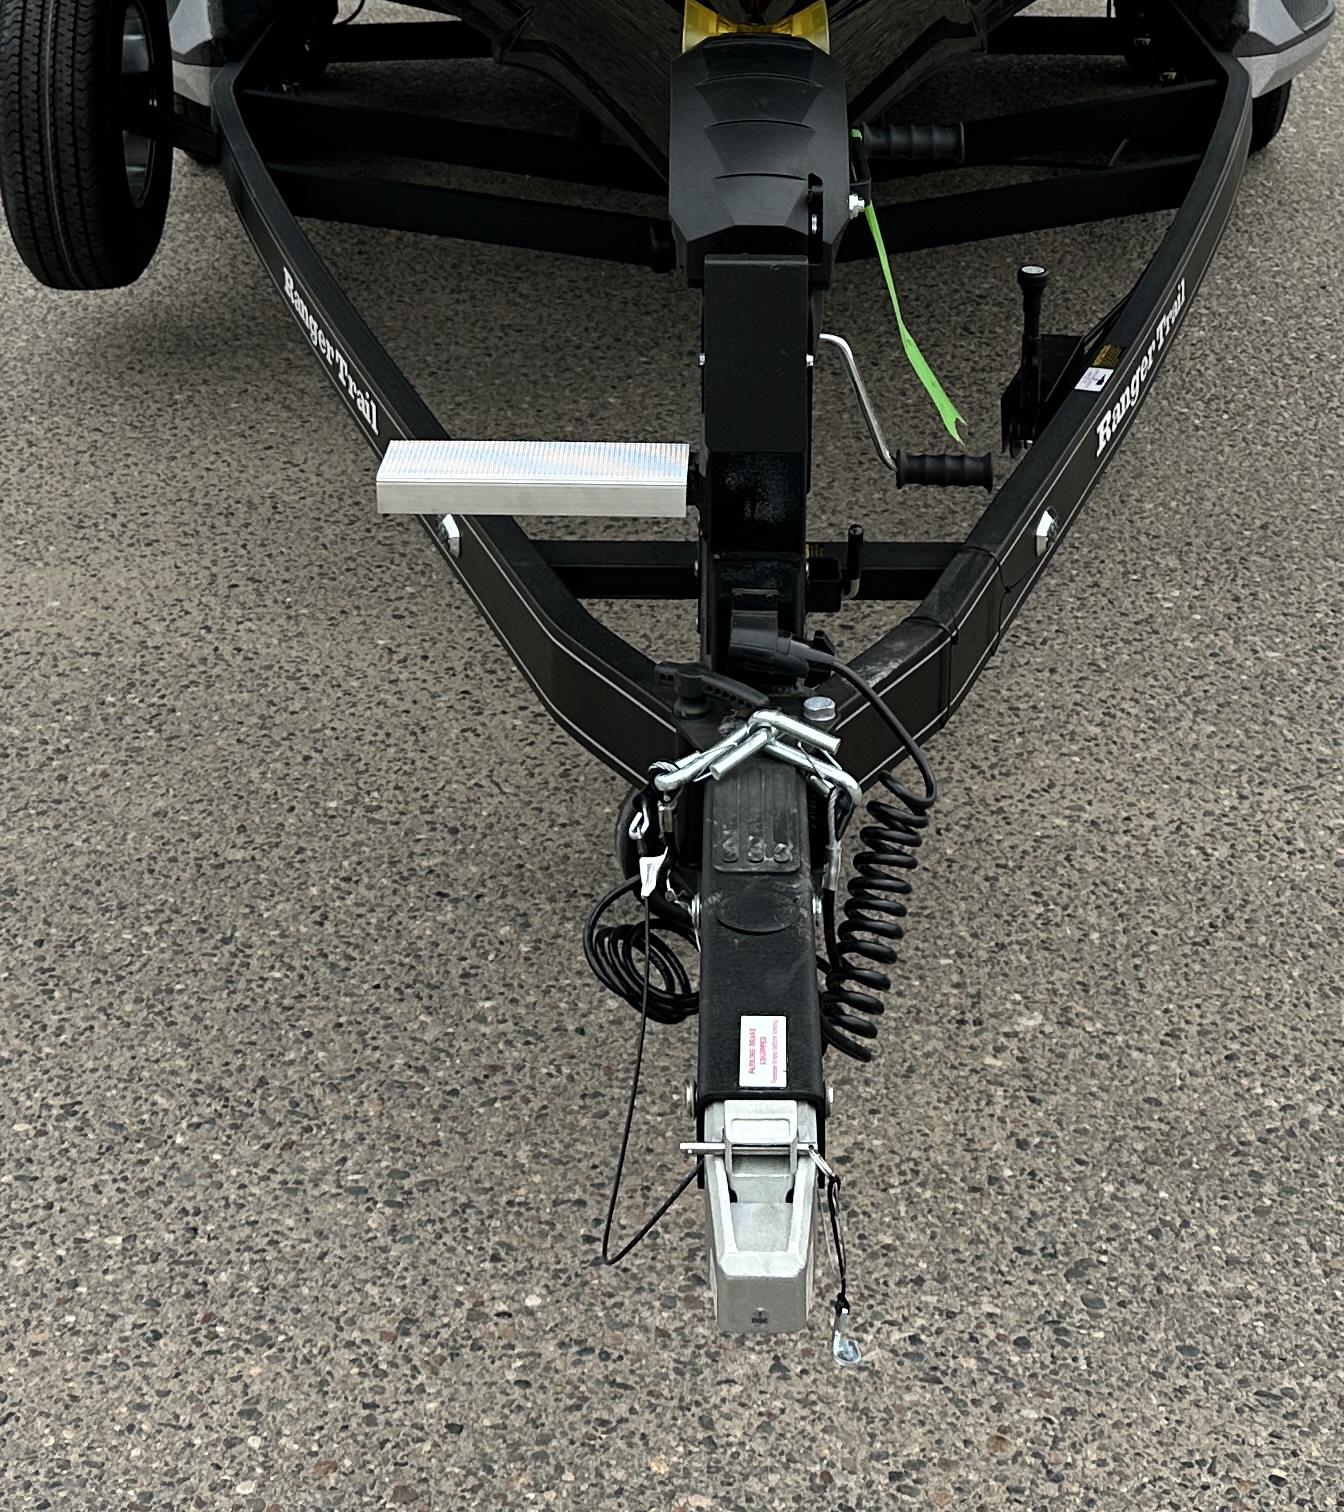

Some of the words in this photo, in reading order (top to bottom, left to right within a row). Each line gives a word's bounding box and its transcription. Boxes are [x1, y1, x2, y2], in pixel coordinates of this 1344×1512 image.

[283, 266, 335, 365] Ranger
[335, 348, 379, 435] Trail
[1096, 339, 1156, 458] Ranger
[1156, 277, 1186, 351] Trail
